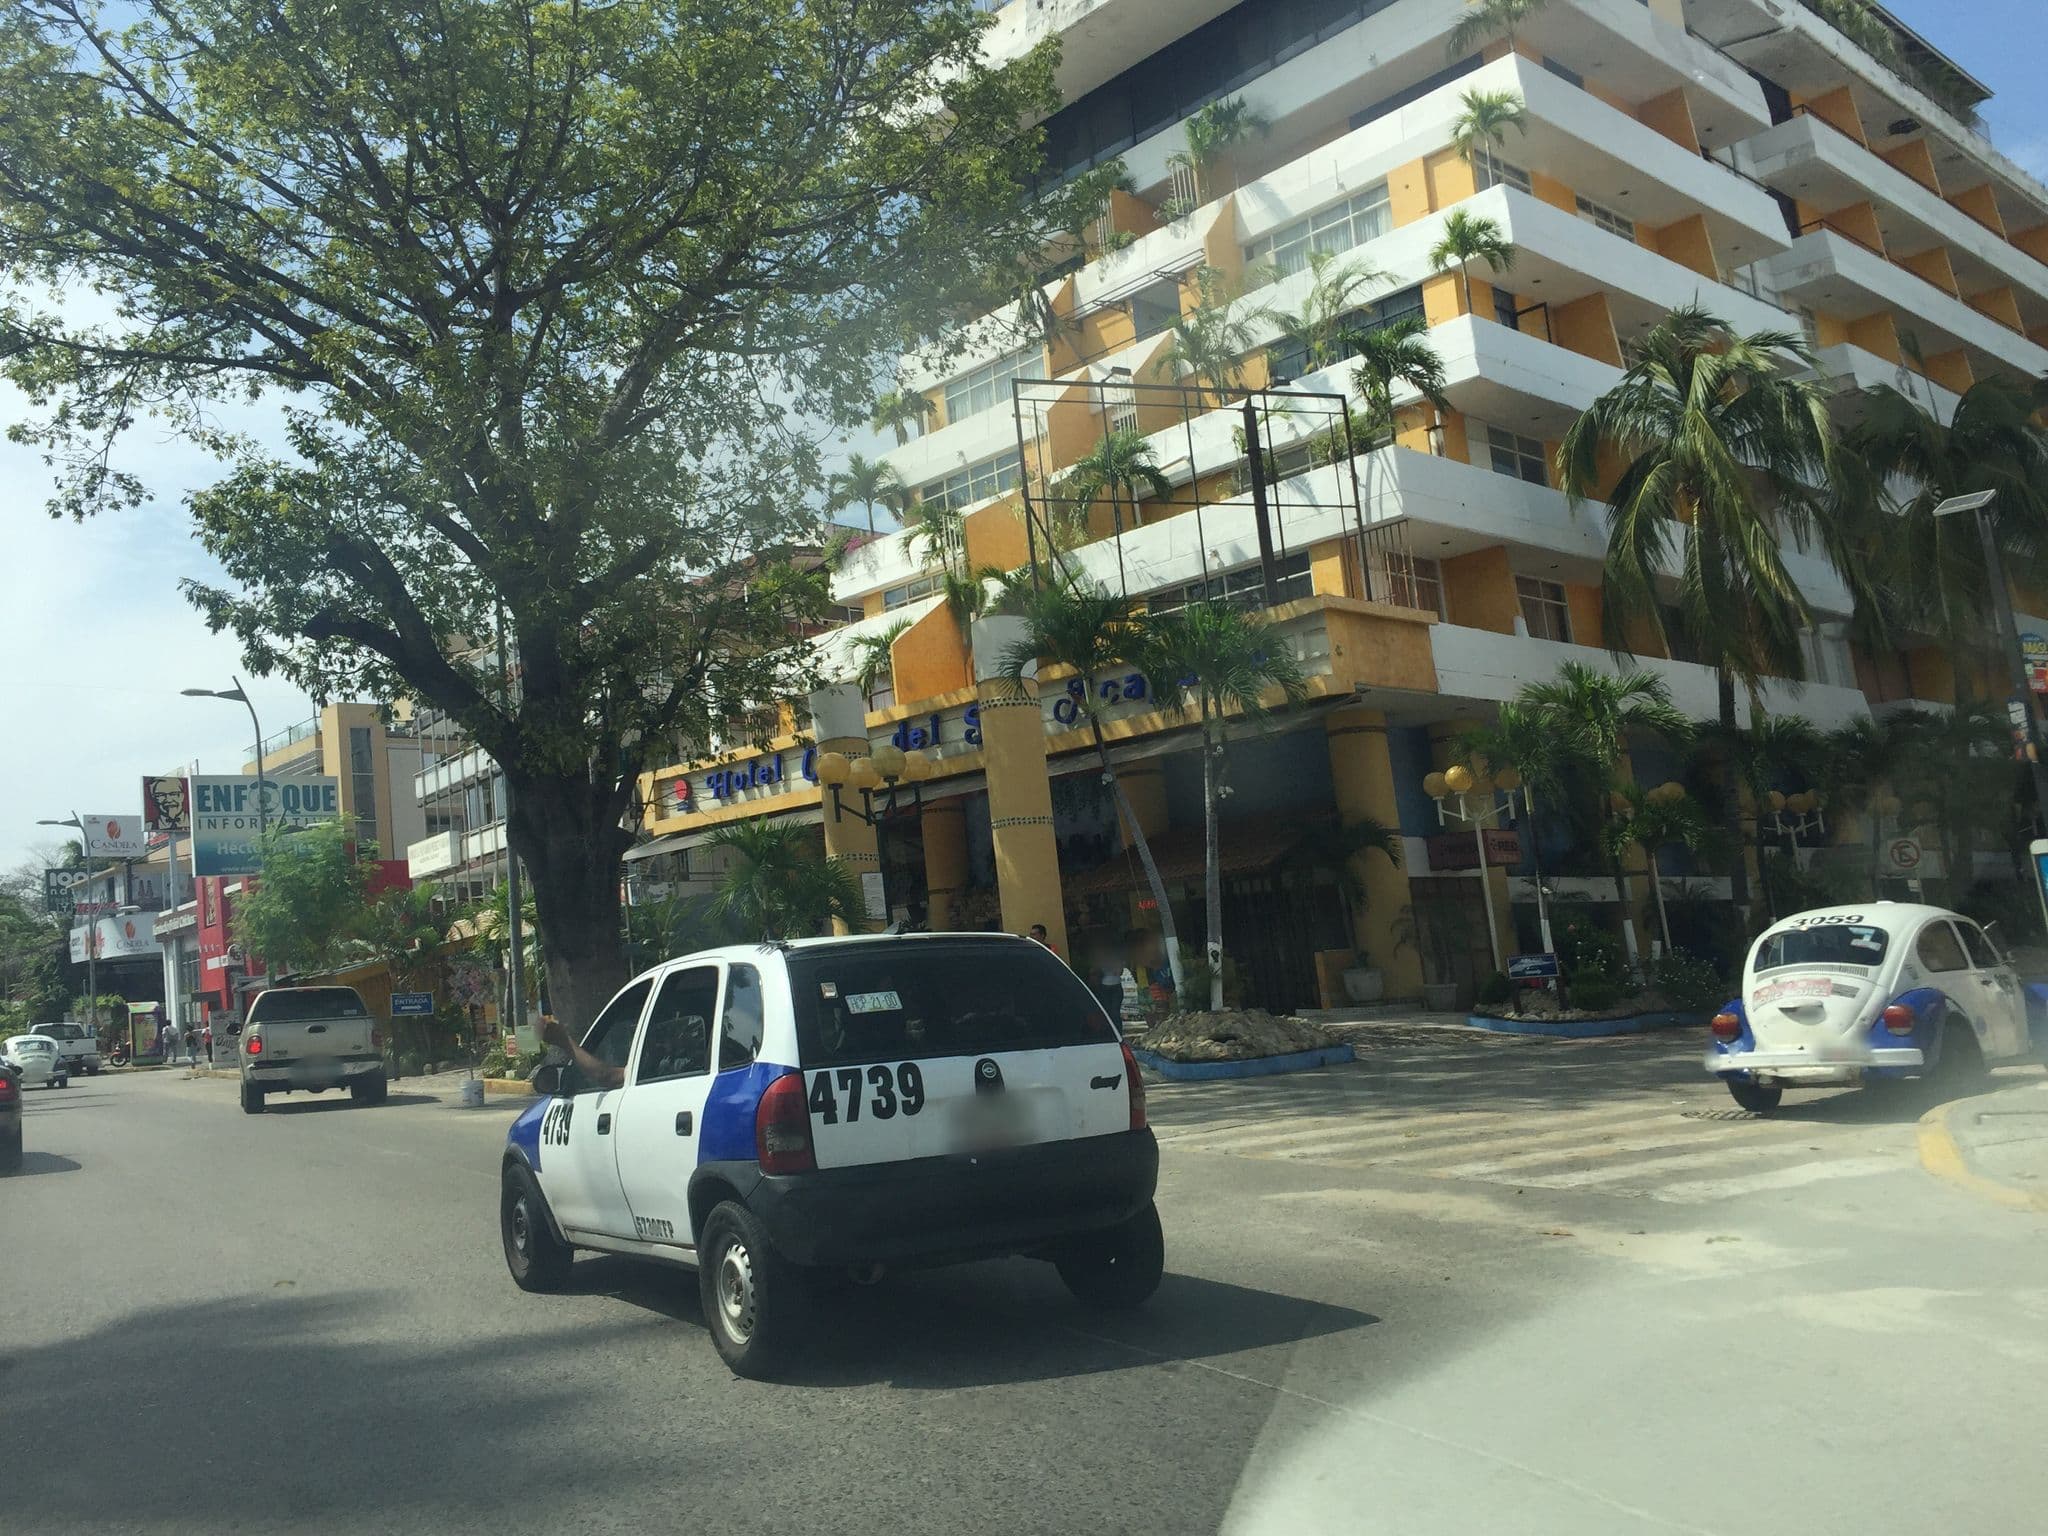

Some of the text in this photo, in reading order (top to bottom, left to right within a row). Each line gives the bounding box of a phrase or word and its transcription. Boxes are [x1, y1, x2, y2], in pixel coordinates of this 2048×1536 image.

[705, 752, 783, 800] Hotel
[891, 714, 940, 752] del
[1789, 914, 1865, 928] 3059
[808, 1061, 926, 1125] 4739
[543, 1103, 575, 1146] 4739
